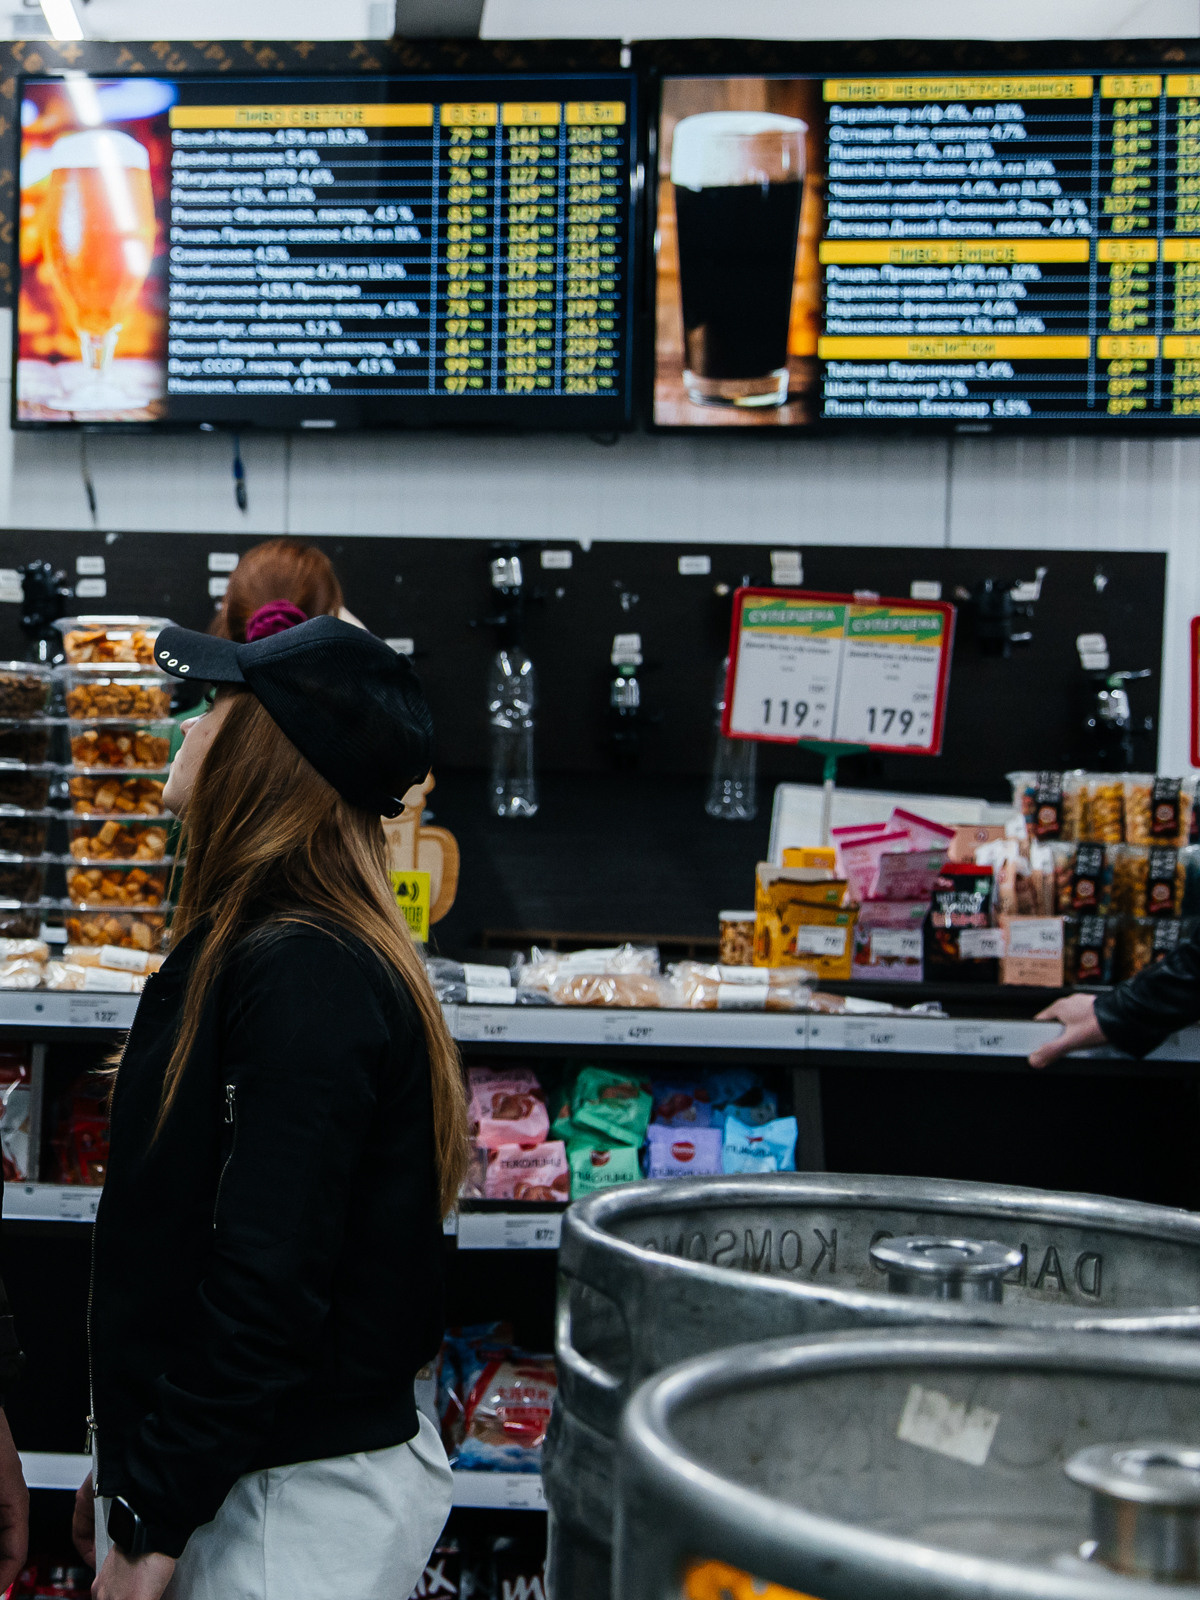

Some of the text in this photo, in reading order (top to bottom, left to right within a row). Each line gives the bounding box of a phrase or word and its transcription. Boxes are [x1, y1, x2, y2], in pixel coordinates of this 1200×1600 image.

[748, 609, 837, 623] СУПЕРЦЕНА
[851, 617, 940, 632] СУПЕРЦЕНА
[762, 698, 809, 727] 119
[867, 707, 914, 736] 179
